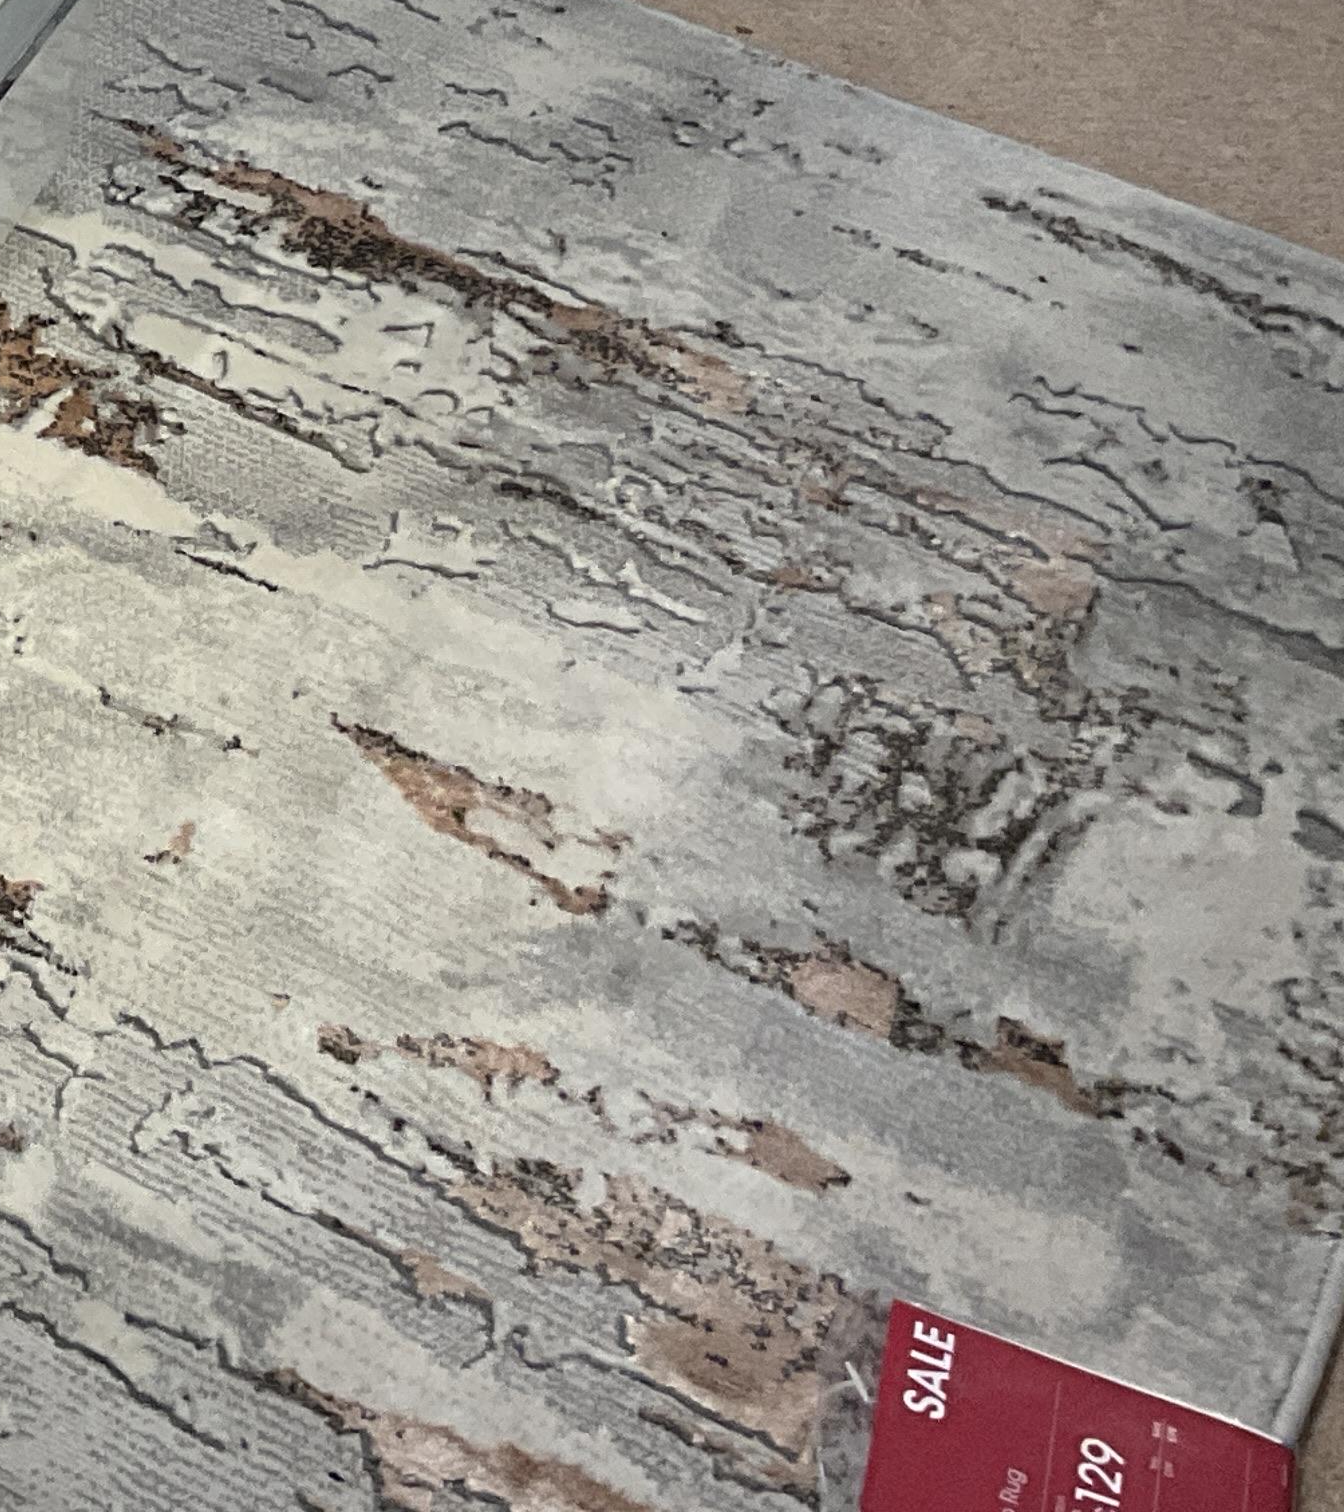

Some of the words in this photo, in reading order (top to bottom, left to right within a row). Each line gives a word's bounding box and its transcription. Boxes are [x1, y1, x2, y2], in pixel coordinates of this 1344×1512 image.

[902, 1320, 956, 1420] SALE
[998, 1467, 1029, 1505] Rug
[1072, 1437, 1127, 1512] 129
